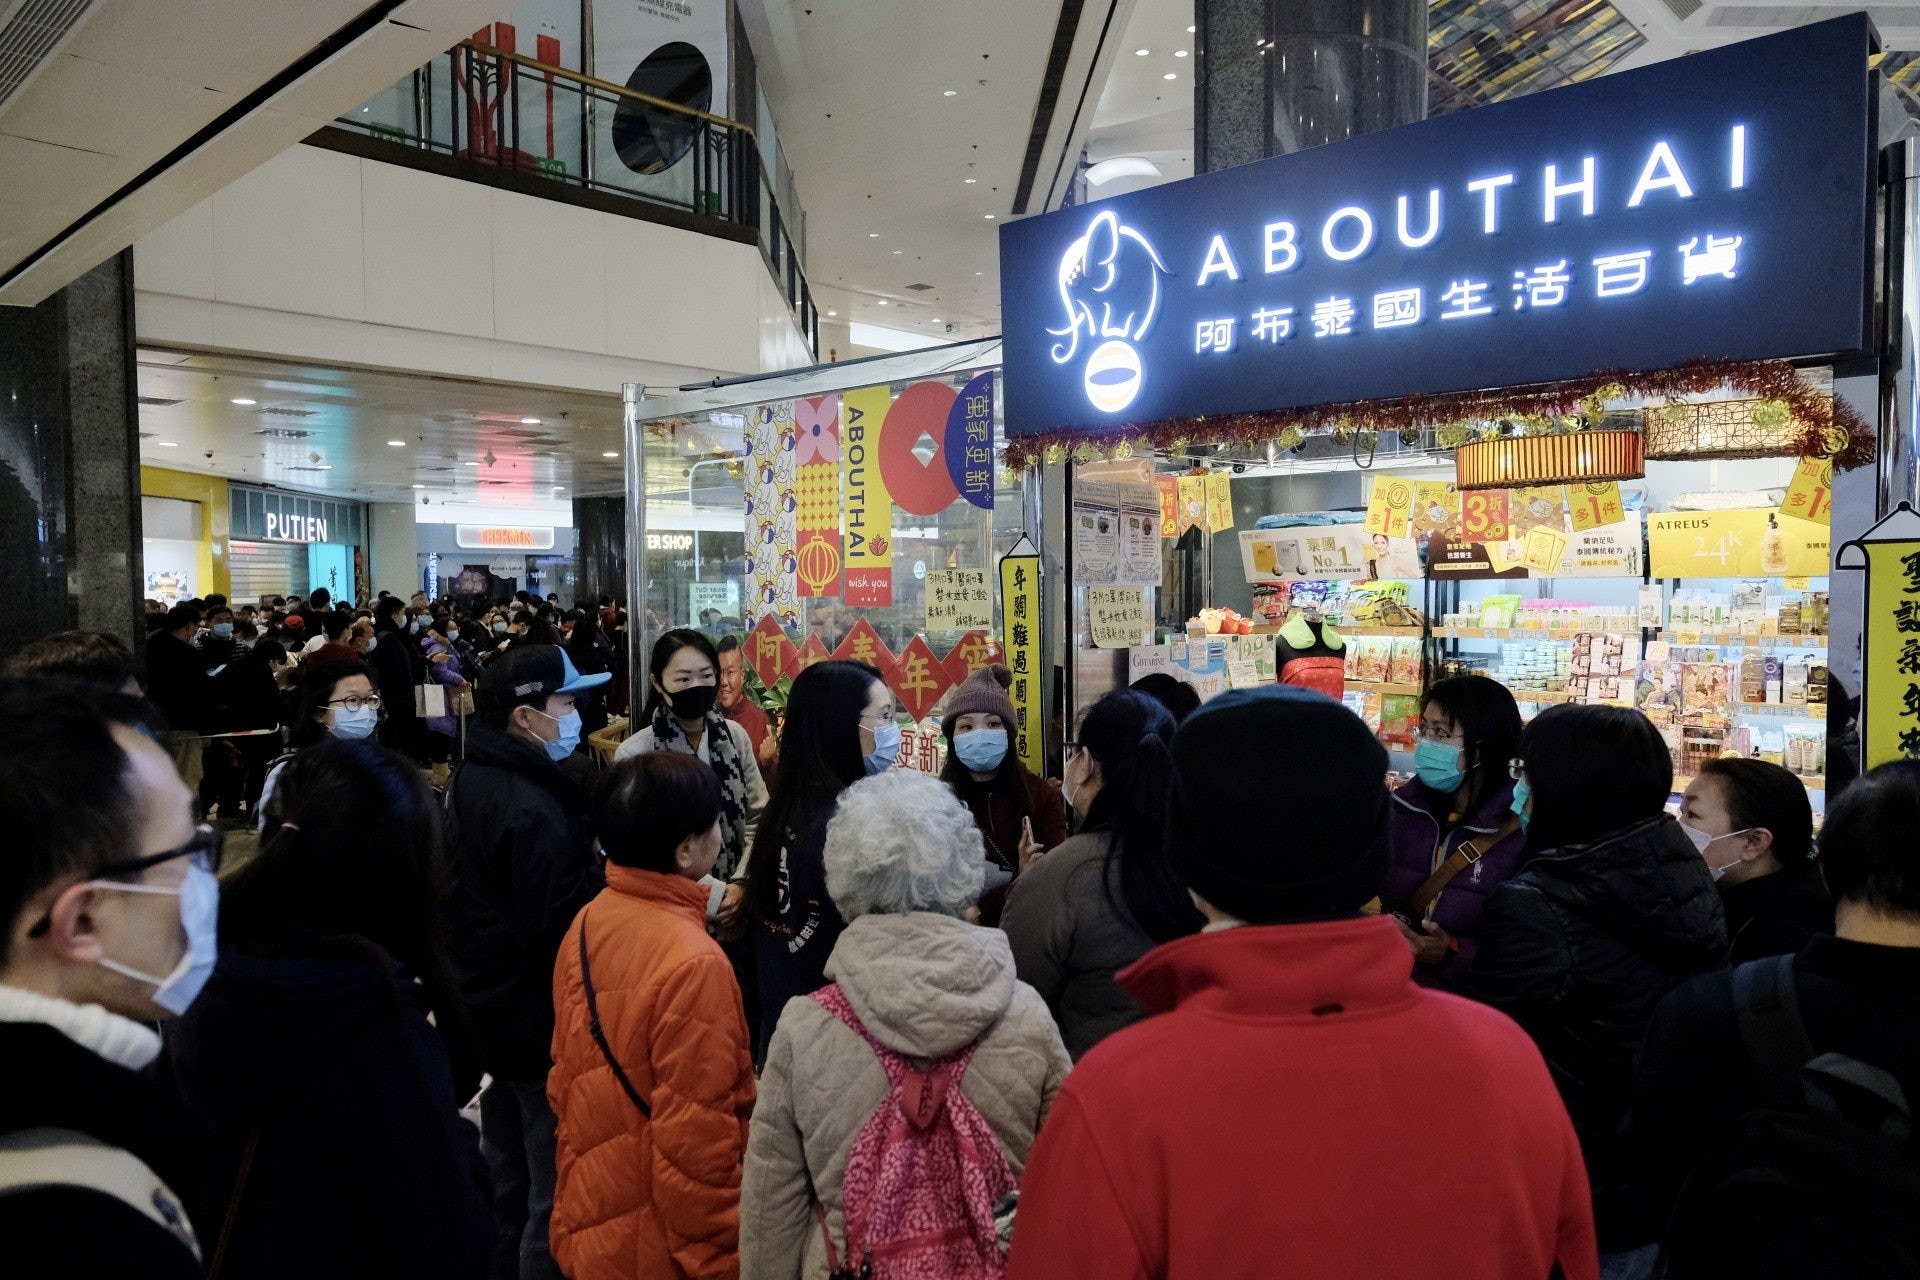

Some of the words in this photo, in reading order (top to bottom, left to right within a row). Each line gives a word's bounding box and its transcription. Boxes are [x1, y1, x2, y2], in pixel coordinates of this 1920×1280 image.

[1194, 122, 1747, 288] ABOUTHAI
[1194, 232, 1744, 354] 阿布泰國生活百貨
[965, 394, 991, 494] 萬家更新
[848, 406, 866, 558] ABOUTHAI
[1370, 507, 1404, 533] 多1件
[1576, 496, 1618, 524] 多1件
[266, 512, 328, 543] PUTIEN
[1656, 518, 1710, 531] ATREUS
[662, 534, 693, 550] SHOP
[1306, 536, 1337, 552] 泰國
[848, 576, 869, 589] wish
[871, 579, 888, 594] you
